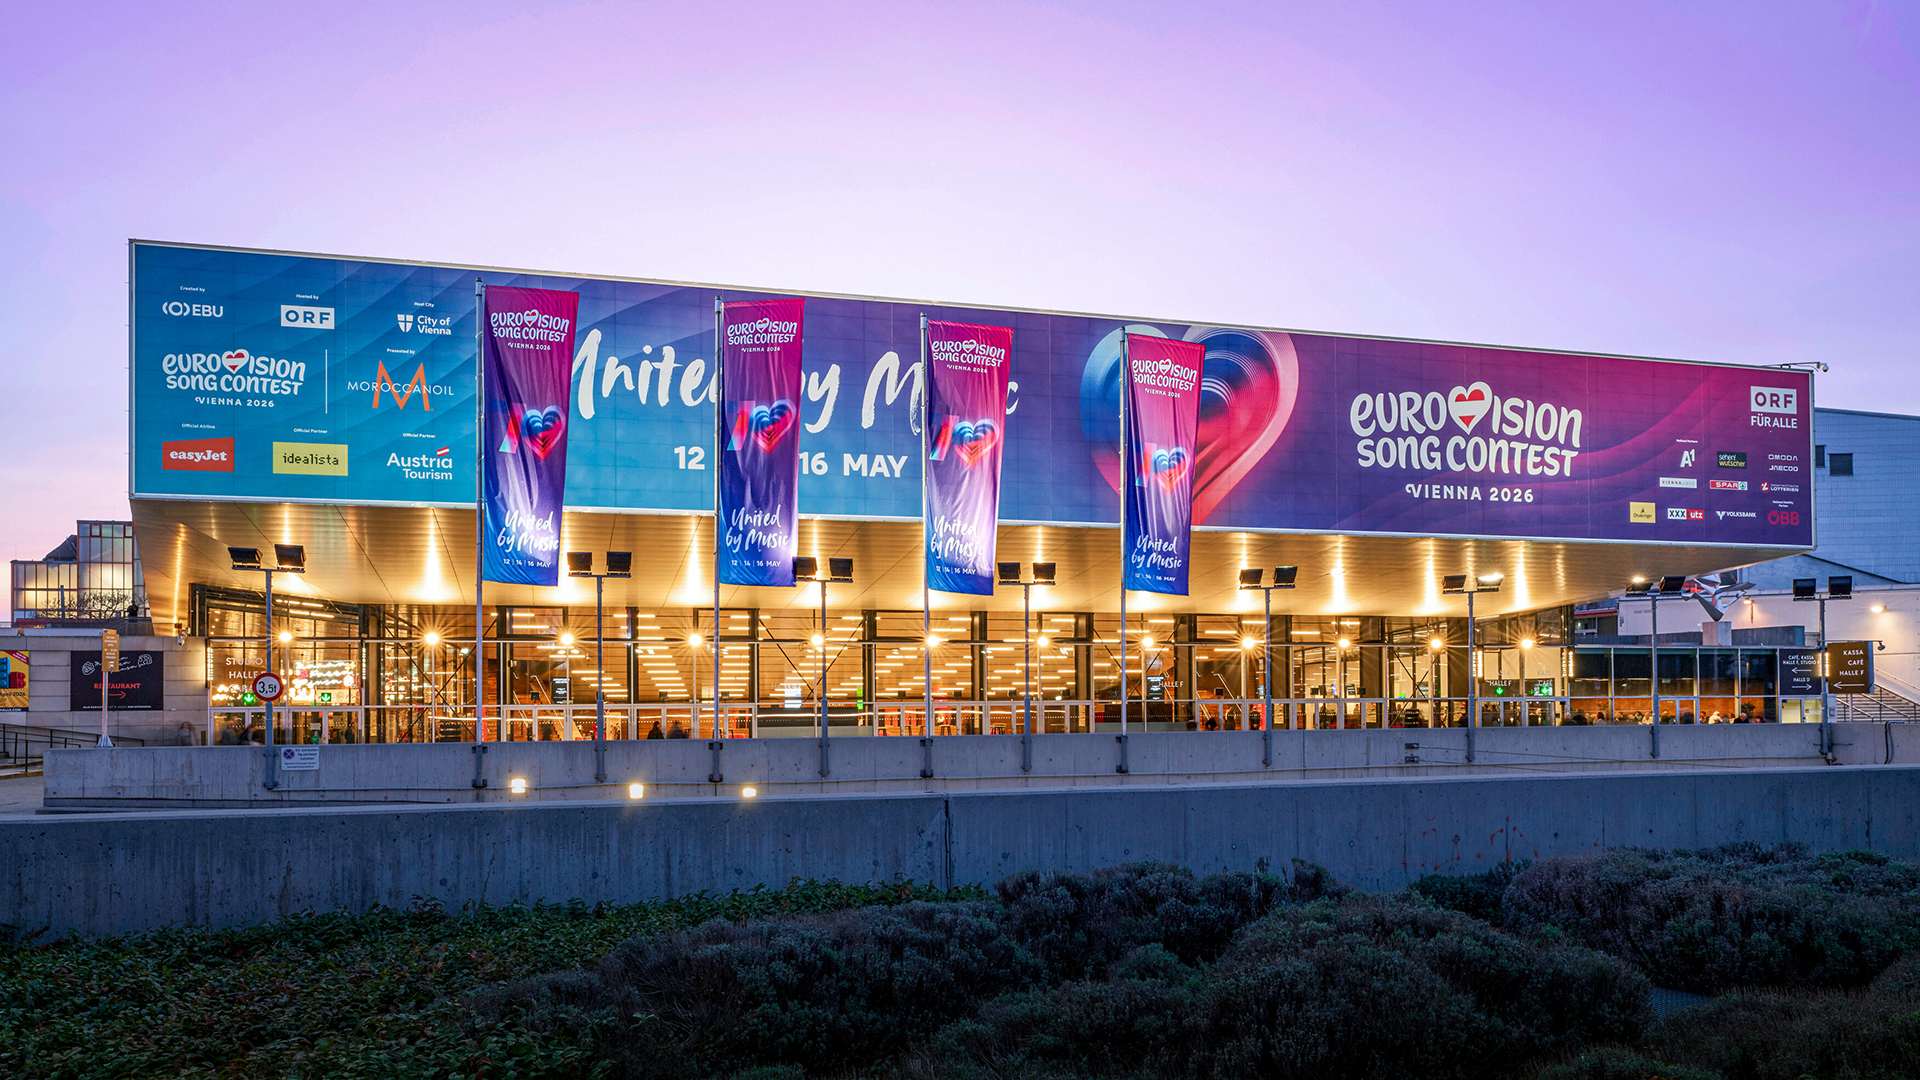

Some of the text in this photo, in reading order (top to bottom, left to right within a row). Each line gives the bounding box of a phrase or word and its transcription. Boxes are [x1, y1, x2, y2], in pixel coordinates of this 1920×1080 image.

[192, 303, 224, 318] EBU
[285, 309, 332, 325] ORF
[417, 315, 451, 327] City of
[417, 324, 452, 335] Vienna
[492, 327, 567, 342] SONG CONTEST
[507, 342, 534, 350] VIENNA
[728, 333, 795, 345] SONG CONTEST
[933, 352, 1003, 367] SONG CONTEST
[946, 364, 971, 372] VIENNA
[166, 374, 303, 396] SONG CONTEST
[347, 381, 454, 396] MOROCCANOIL
[1134, 373, 1195, 391] SONG CONTEST
[1144, 387, 1167, 396] VIENNA
[195, 396, 275, 407] VIENNA 2026
[1754, 391, 1794, 408] ORF
[1751, 413, 1798, 429] FÜR ALLE
[169, 450, 228, 462] easyJet
[282, 452, 339, 466] idealista
[386, 452, 453, 469] Austria
[674, 446, 908, 478] 12 16 MAY
[1357, 435, 1579, 477] SONG CONTEST
[1680, 448, 1695, 468] A1
[402, 468, 453, 480] Tourism
[1405, 484, 1534, 503] VIENNA 2026
[505, 509, 554, 534] United
[731, 504, 781, 531] United
[1669, 509, 1703, 519] XXXLutz
[934, 514, 979, 539] United
[497, 527, 559, 554] by Music
[725, 526, 789, 553] by Music
[931, 532, 985, 560] by Music
[1137, 534, 1178, 554] United
[1131, 548, 1182, 570] by Music
[225, 657, 263, 665] STUDIO
[1847, 658, 1864, 666] CAFÉ
[228, 671, 259, 679] HALLE
